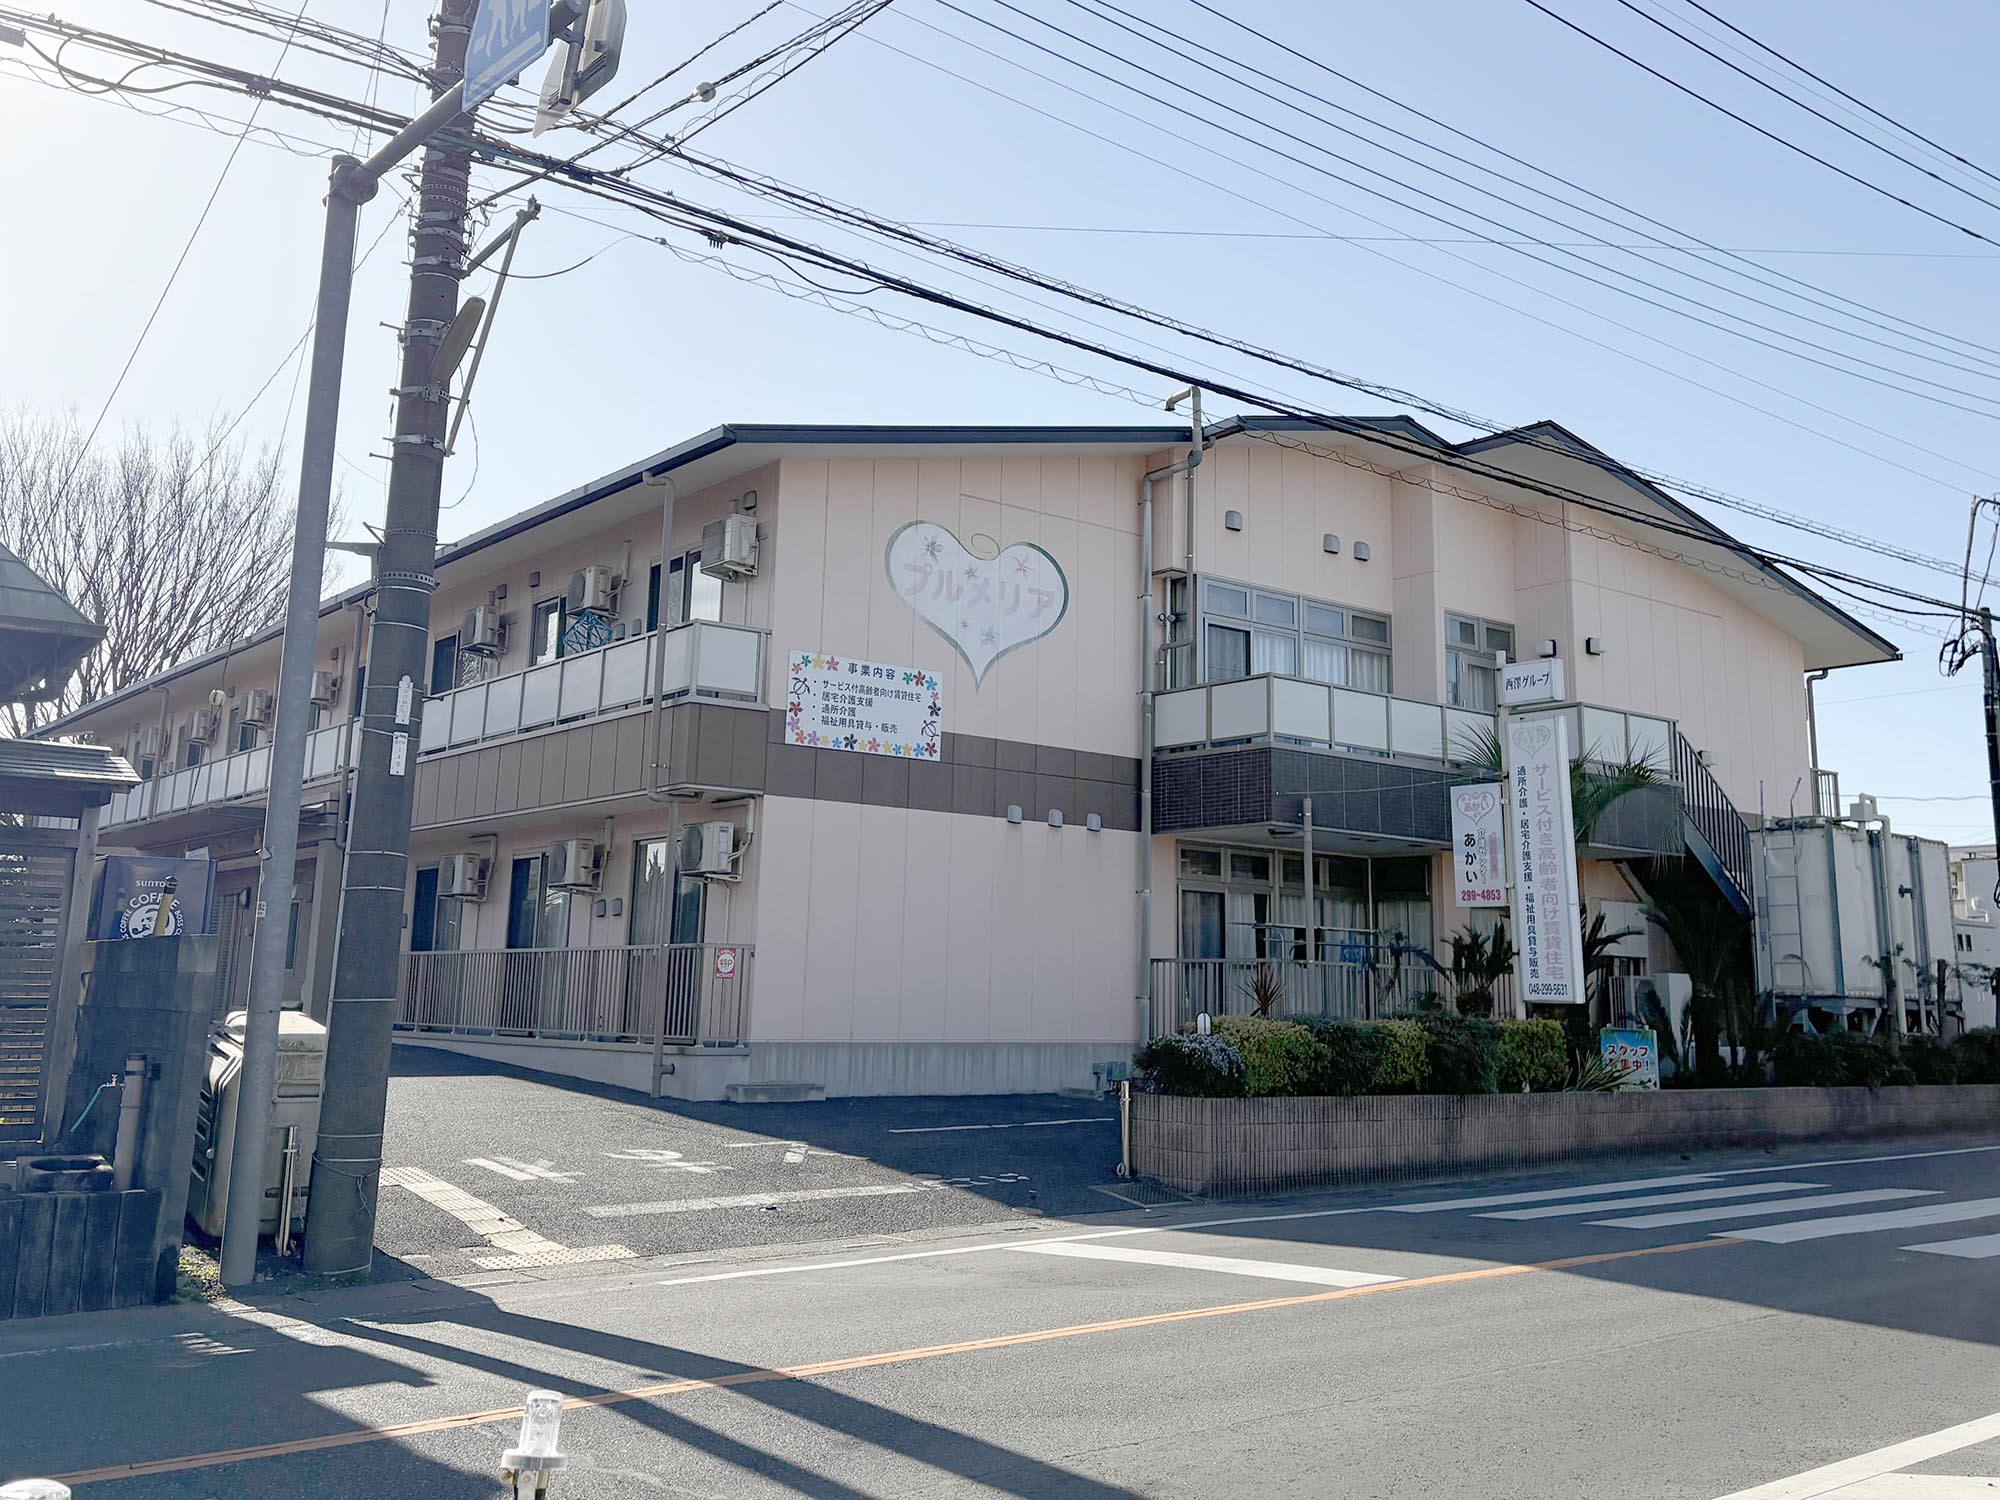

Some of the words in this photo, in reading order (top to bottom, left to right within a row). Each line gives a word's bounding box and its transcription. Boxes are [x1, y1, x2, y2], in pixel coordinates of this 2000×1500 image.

[904, 562, 1056, 619] プルメリア
[847, 662, 897, 680] 事業内容
[1505, 671, 1551, 691] 西澤グループ
[821, 691, 874, 708] 居宅介護支援
[822, 679, 922, 703] サービス付高齢者向け賃貸住宅
[821, 703, 857, 717] 通所介護
[821, 715, 898, 734] 福祉用具貸与・販売
[1463, 800, 1490, 813] あかい
[1464, 833, 1478, 884] あかい
[1533, 763, 1565, 980] サービス付き高齢者向け賃貸住宅
[135, 879, 167, 888] SUNTO
[129, 892, 180, 910] COFFE
[1461, 888, 1501, 902] 299-4853
[1528, 983, 1568, 997] 048-299-5631
